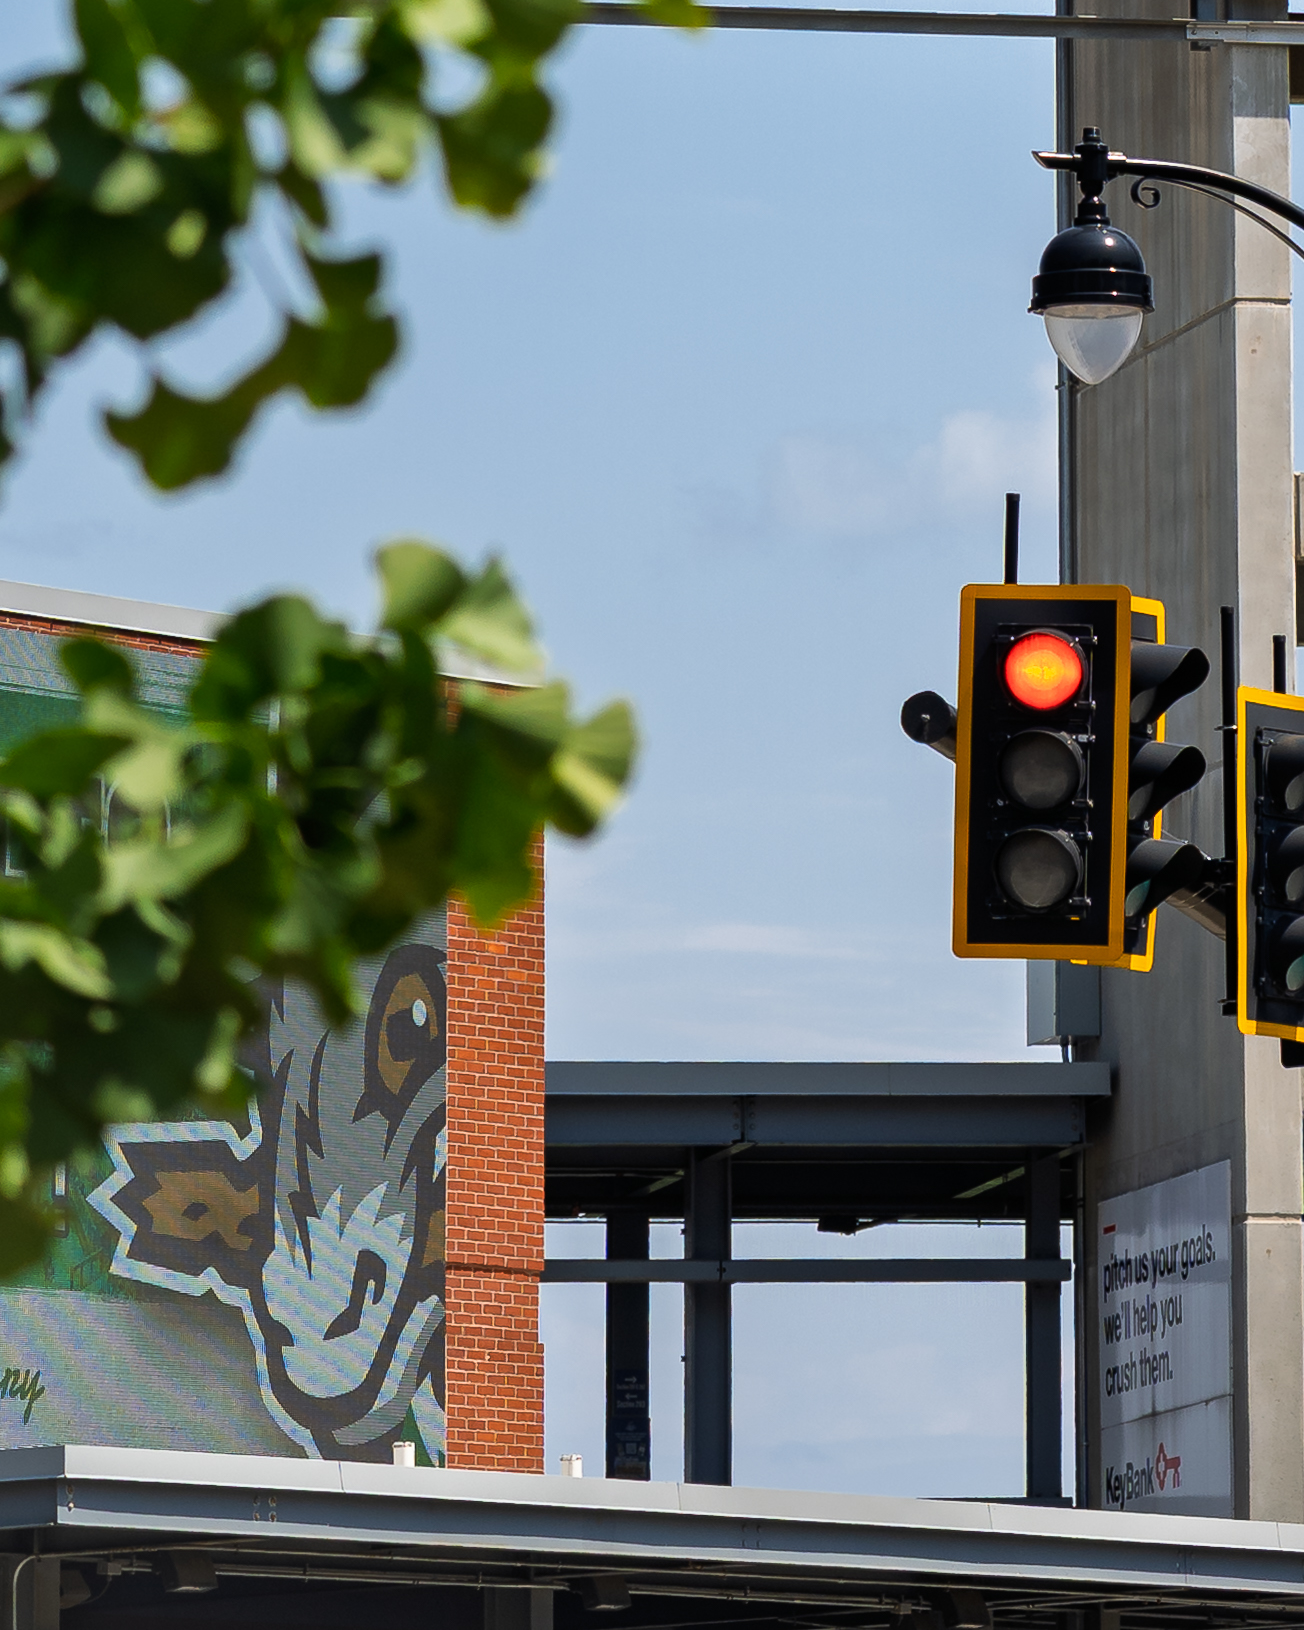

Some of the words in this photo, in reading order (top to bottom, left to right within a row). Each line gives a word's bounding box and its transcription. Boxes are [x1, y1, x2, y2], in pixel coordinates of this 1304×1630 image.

[1103, 1249, 1132, 1303] pitch
[1135, 1253, 1149, 1284] us
[1151, 1243, 1179, 1289] your
[1181, 1224, 1216, 1281] goals.
[1104, 1300, 1131, 1345] we'll
[1133, 1298, 1158, 1342] help
[1160, 1294, 1183, 1339] you
[1106, 1351, 1138, 1397] crush
[1139, 1347, 1173, 1388] them.
[1106, 1458, 1155, 1510] KeyBank
